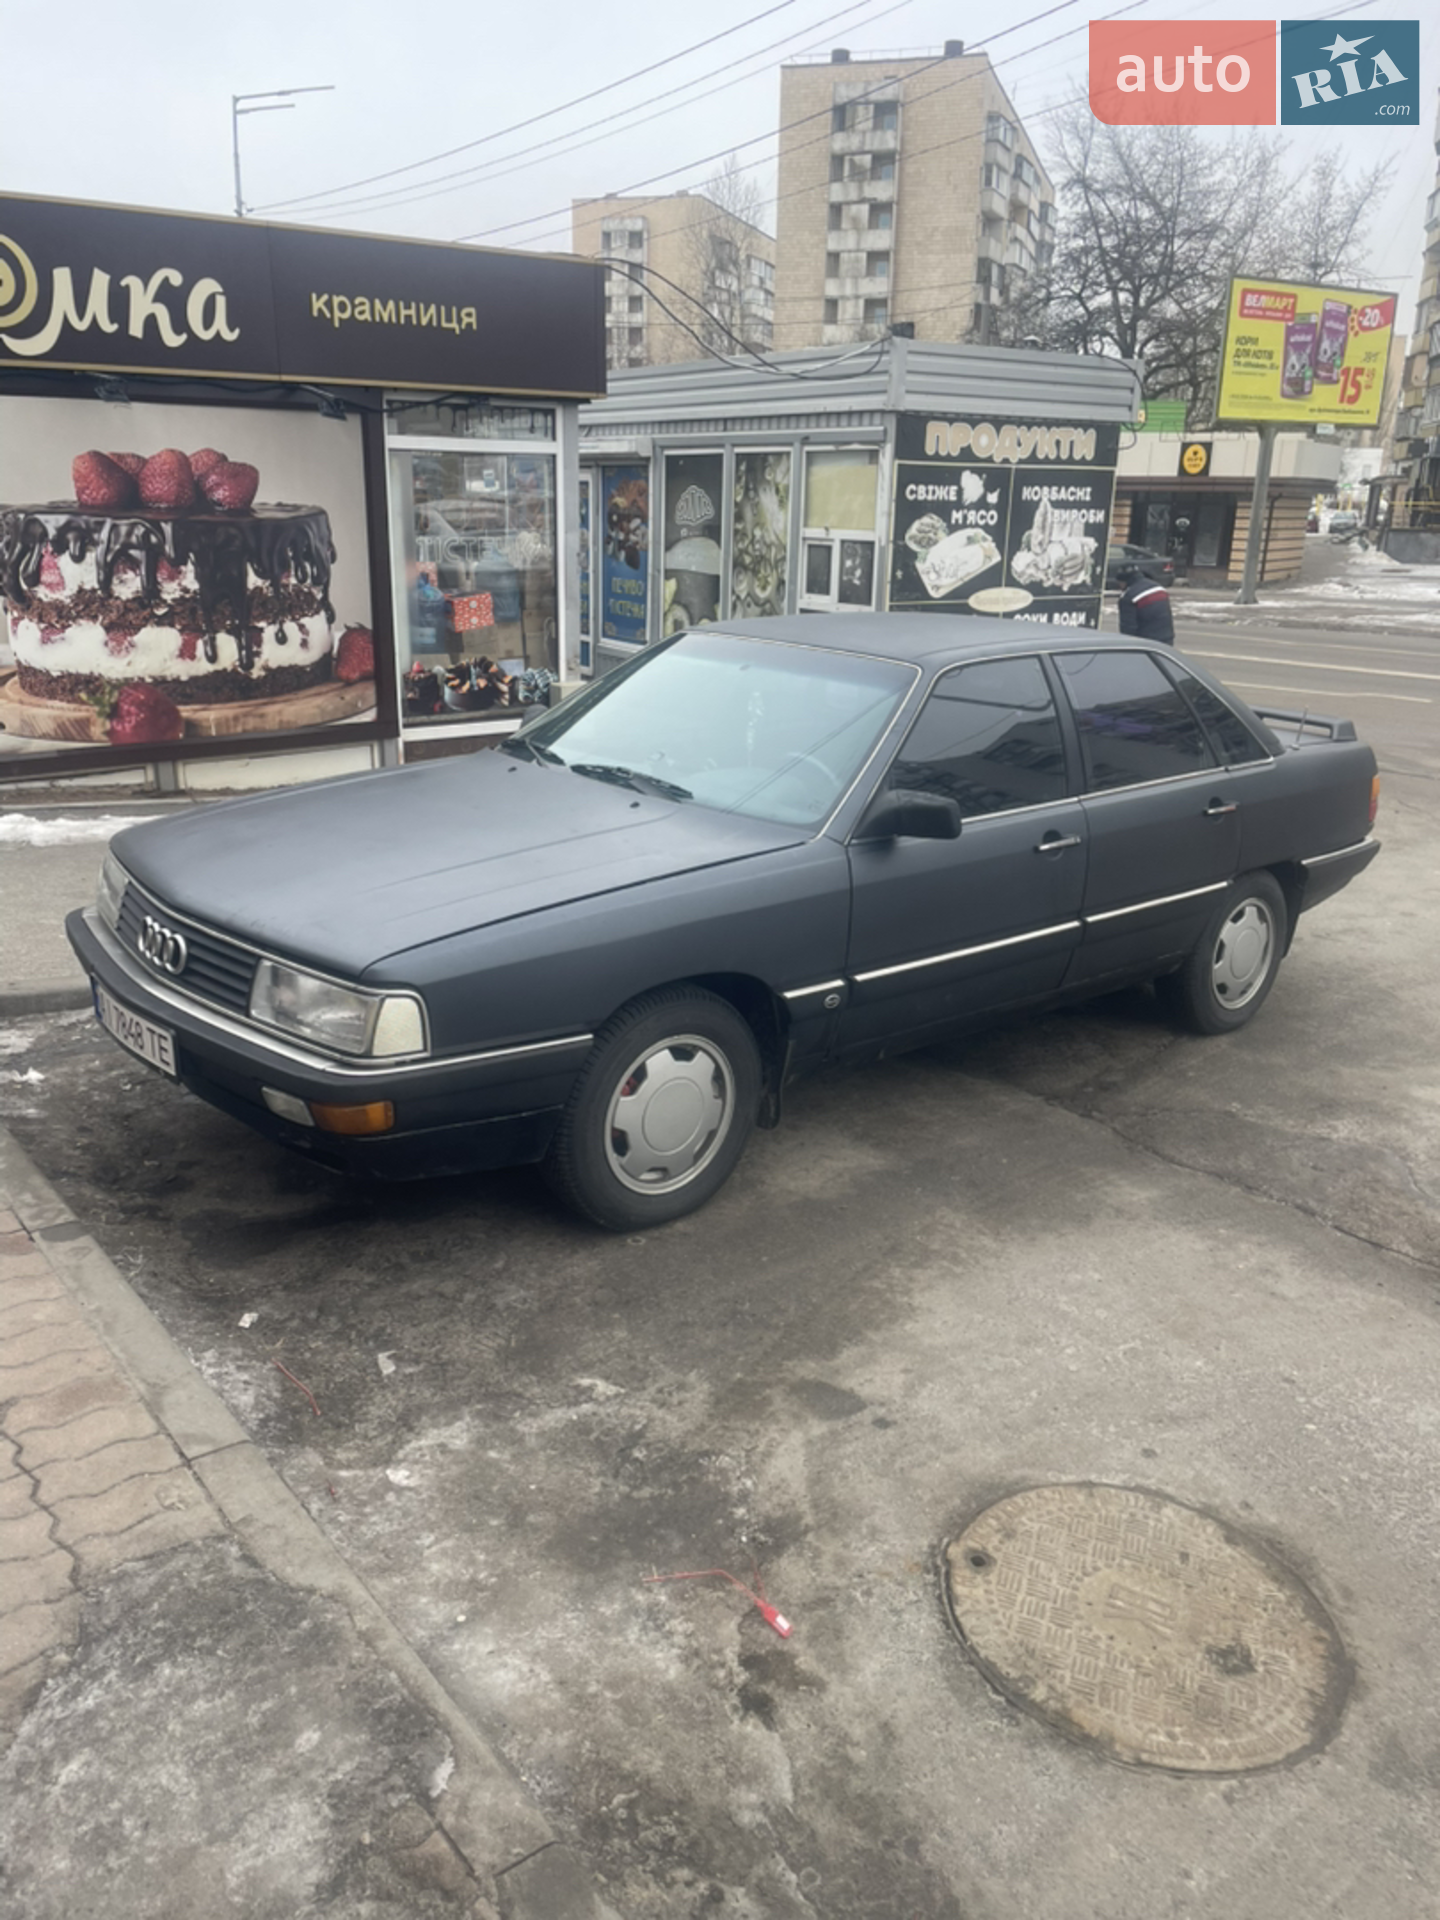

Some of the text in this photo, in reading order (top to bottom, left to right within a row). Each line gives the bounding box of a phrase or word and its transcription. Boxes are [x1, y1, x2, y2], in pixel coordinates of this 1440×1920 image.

[309, 290, 479, 334] крамниця
[1338, 366, 1365, 405] 15
[924, 420, 1097, 464] ПРОДУКТИ
[904, 484, 958, 502] СВІЖЕ
[1021, 485, 1093, 502] КОВБАСНІ
[951, 509, 999, 526] М'ЯСО
[1051, 509, 1106, 524] ВИРОБИ
[146, 1025, 172, 1068] TE
